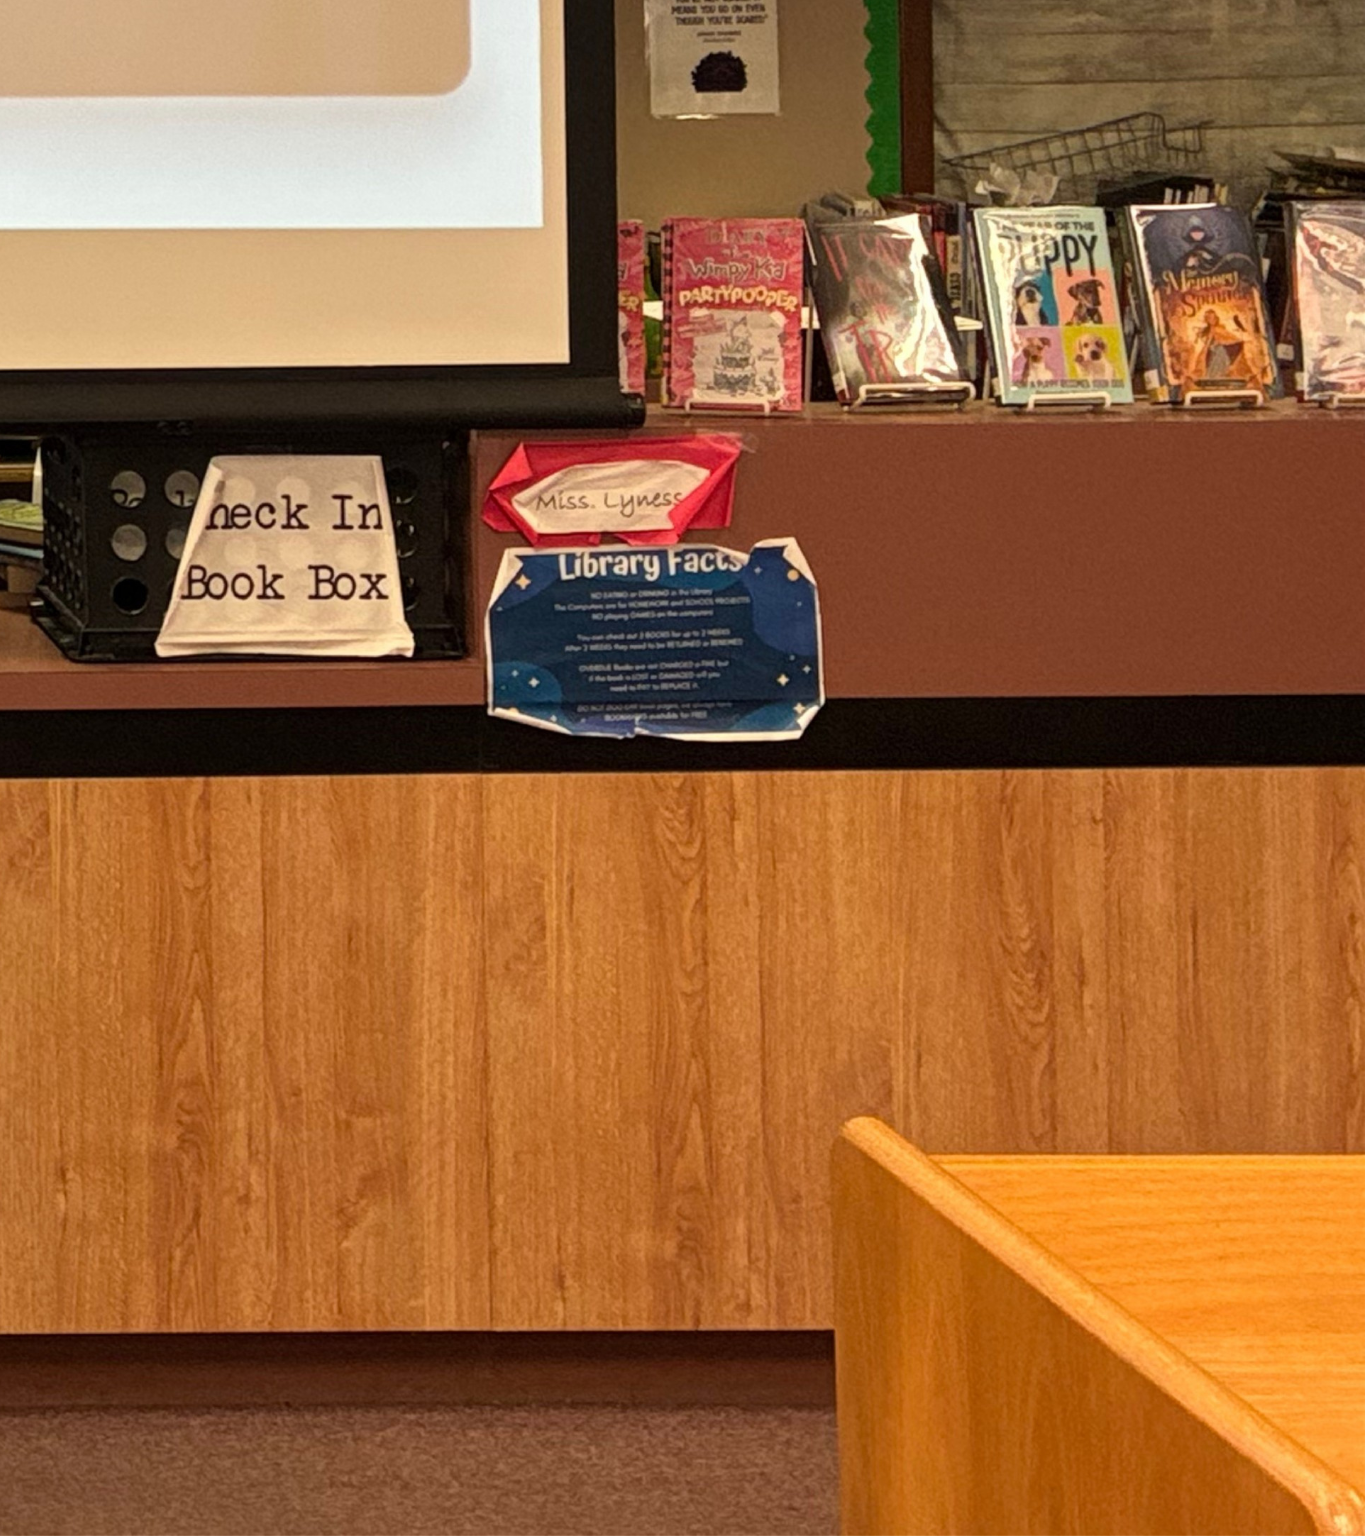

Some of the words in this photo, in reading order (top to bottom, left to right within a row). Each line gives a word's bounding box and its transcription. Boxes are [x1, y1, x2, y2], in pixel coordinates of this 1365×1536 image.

[1055, 222, 1073, 231] OF
[1073, 221, 1096, 232] THE
[687, 257, 752, 288] Wimpy
[754, 258, 788, 281] Kid
[1162, 271, 1239, 291] Memory
[679, 284, 800, 313] PARTYPOOPER
[331, 494, 384, 530] In
[535, 490, 596, 511] Miss.
[604, 491, 683, 517] Lyness
[558, 550, 660, 582] Library
[667, 547, 743, 576] Facts
[180, 564, 285, 600] Book
[307, 564, 389, 600] Box
